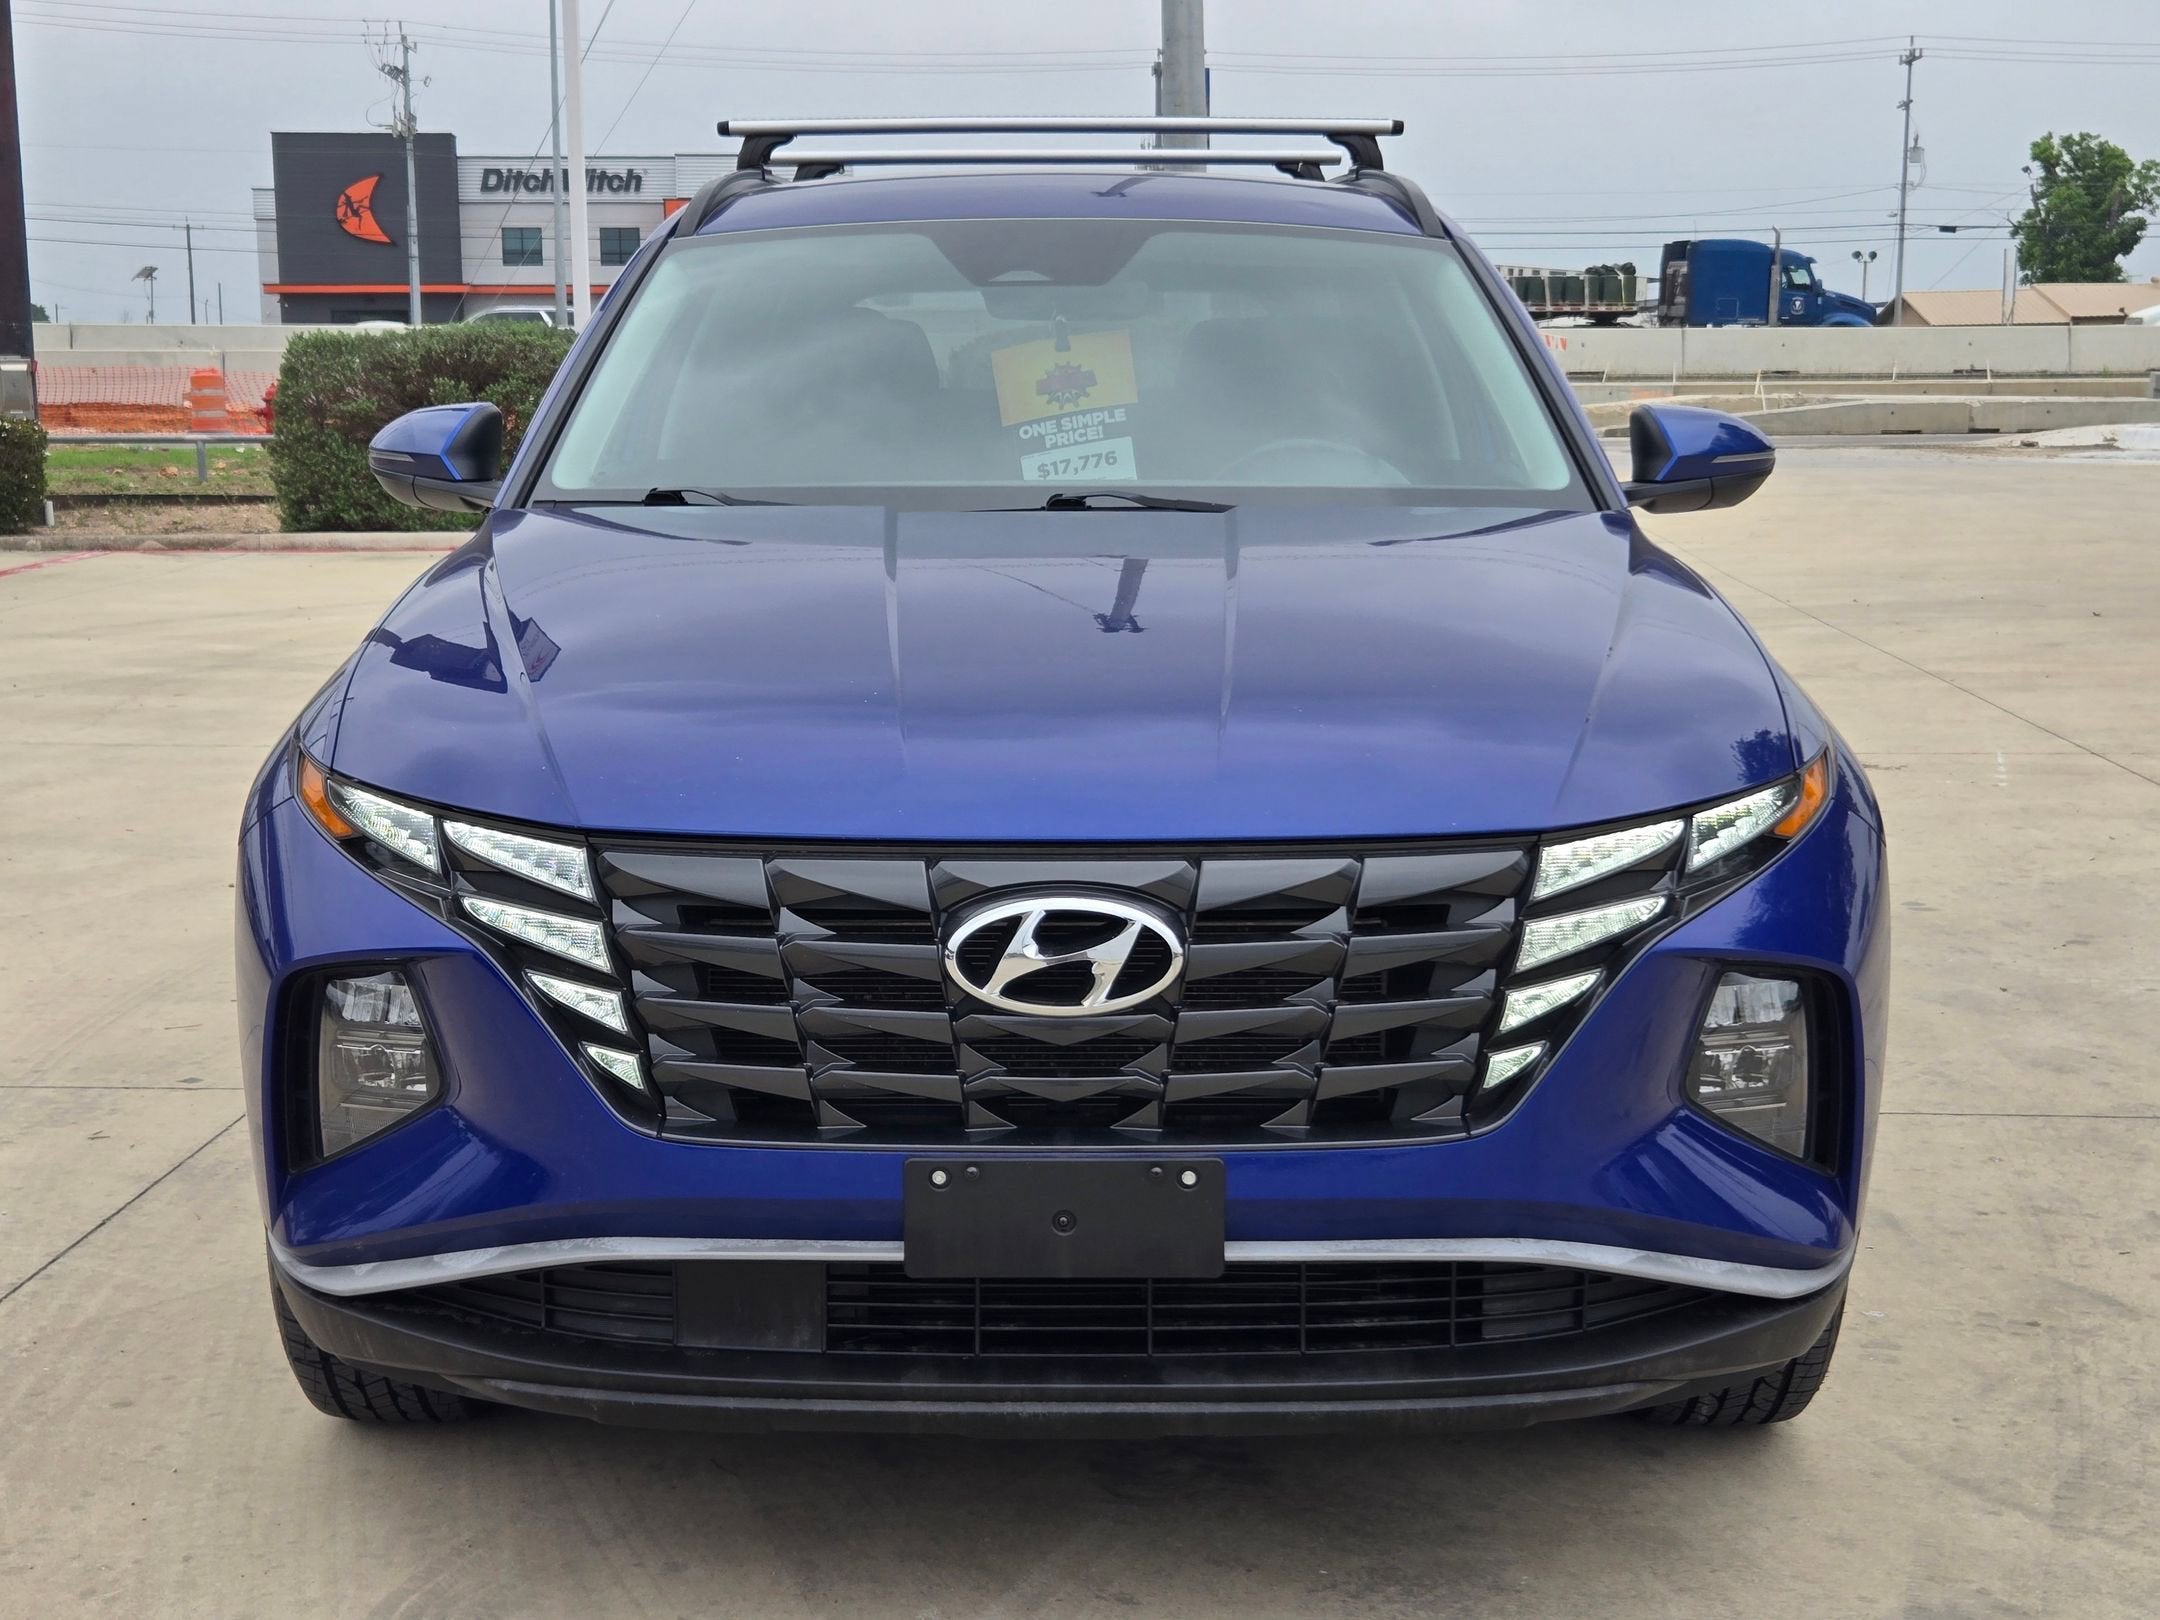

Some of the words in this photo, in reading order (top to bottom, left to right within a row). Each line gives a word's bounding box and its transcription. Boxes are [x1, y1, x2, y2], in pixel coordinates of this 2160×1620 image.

[480, 168, 554, 192] Ditch
[1019, 420, 1058, 439] ONE
[1061, 408, 1127, 430] SIMPLE
[1045, 425, 1104, 449] PRICE!
[1037, 450, 1118, 480] $17,776
